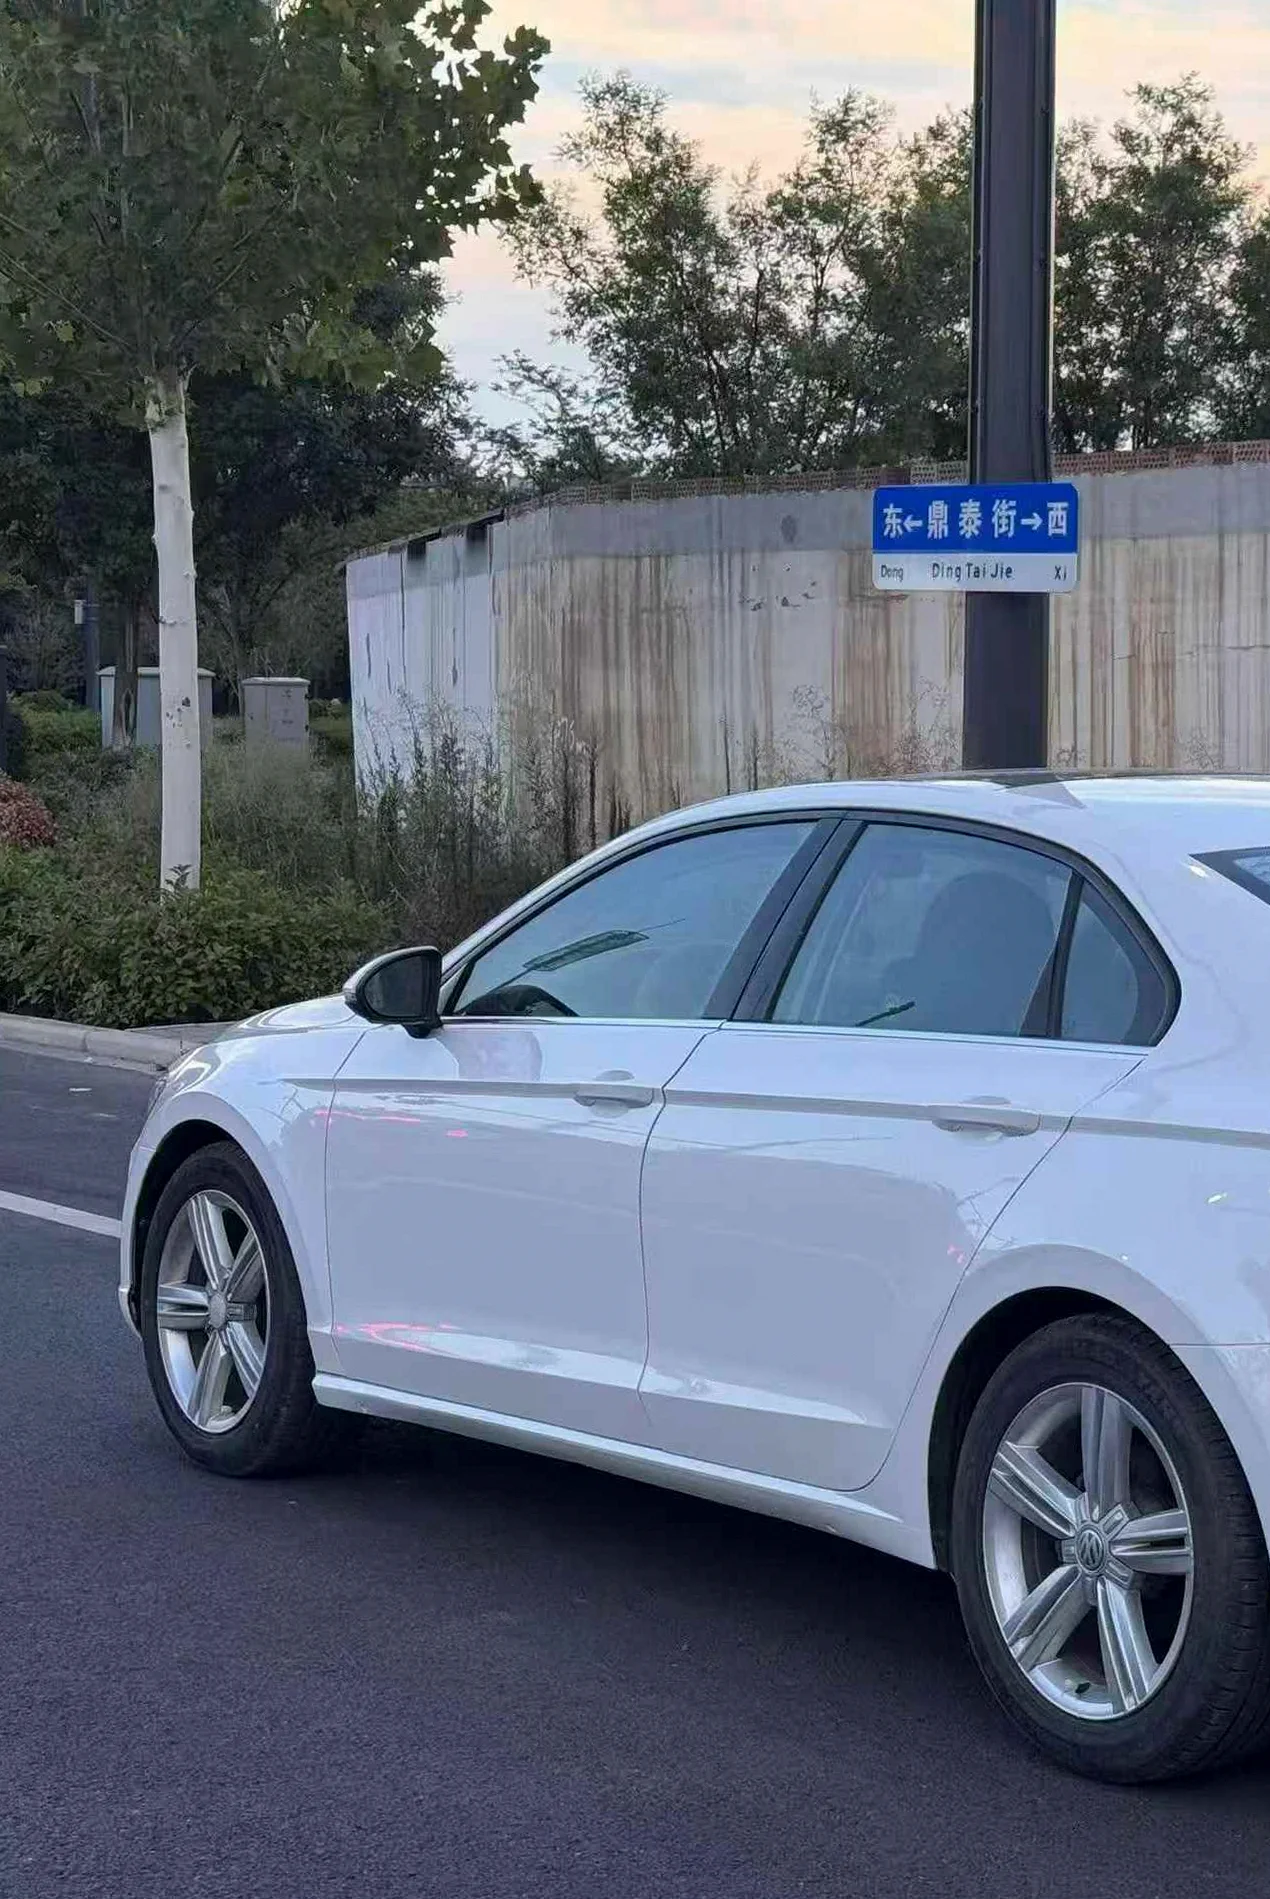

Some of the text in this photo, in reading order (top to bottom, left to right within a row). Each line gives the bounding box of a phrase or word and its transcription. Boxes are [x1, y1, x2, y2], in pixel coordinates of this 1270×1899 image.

[883, 498, 1069, 540] 东 鼎泰街 西
[881, 563, 1067, 581] Dong Ding Tai Jie Xi
